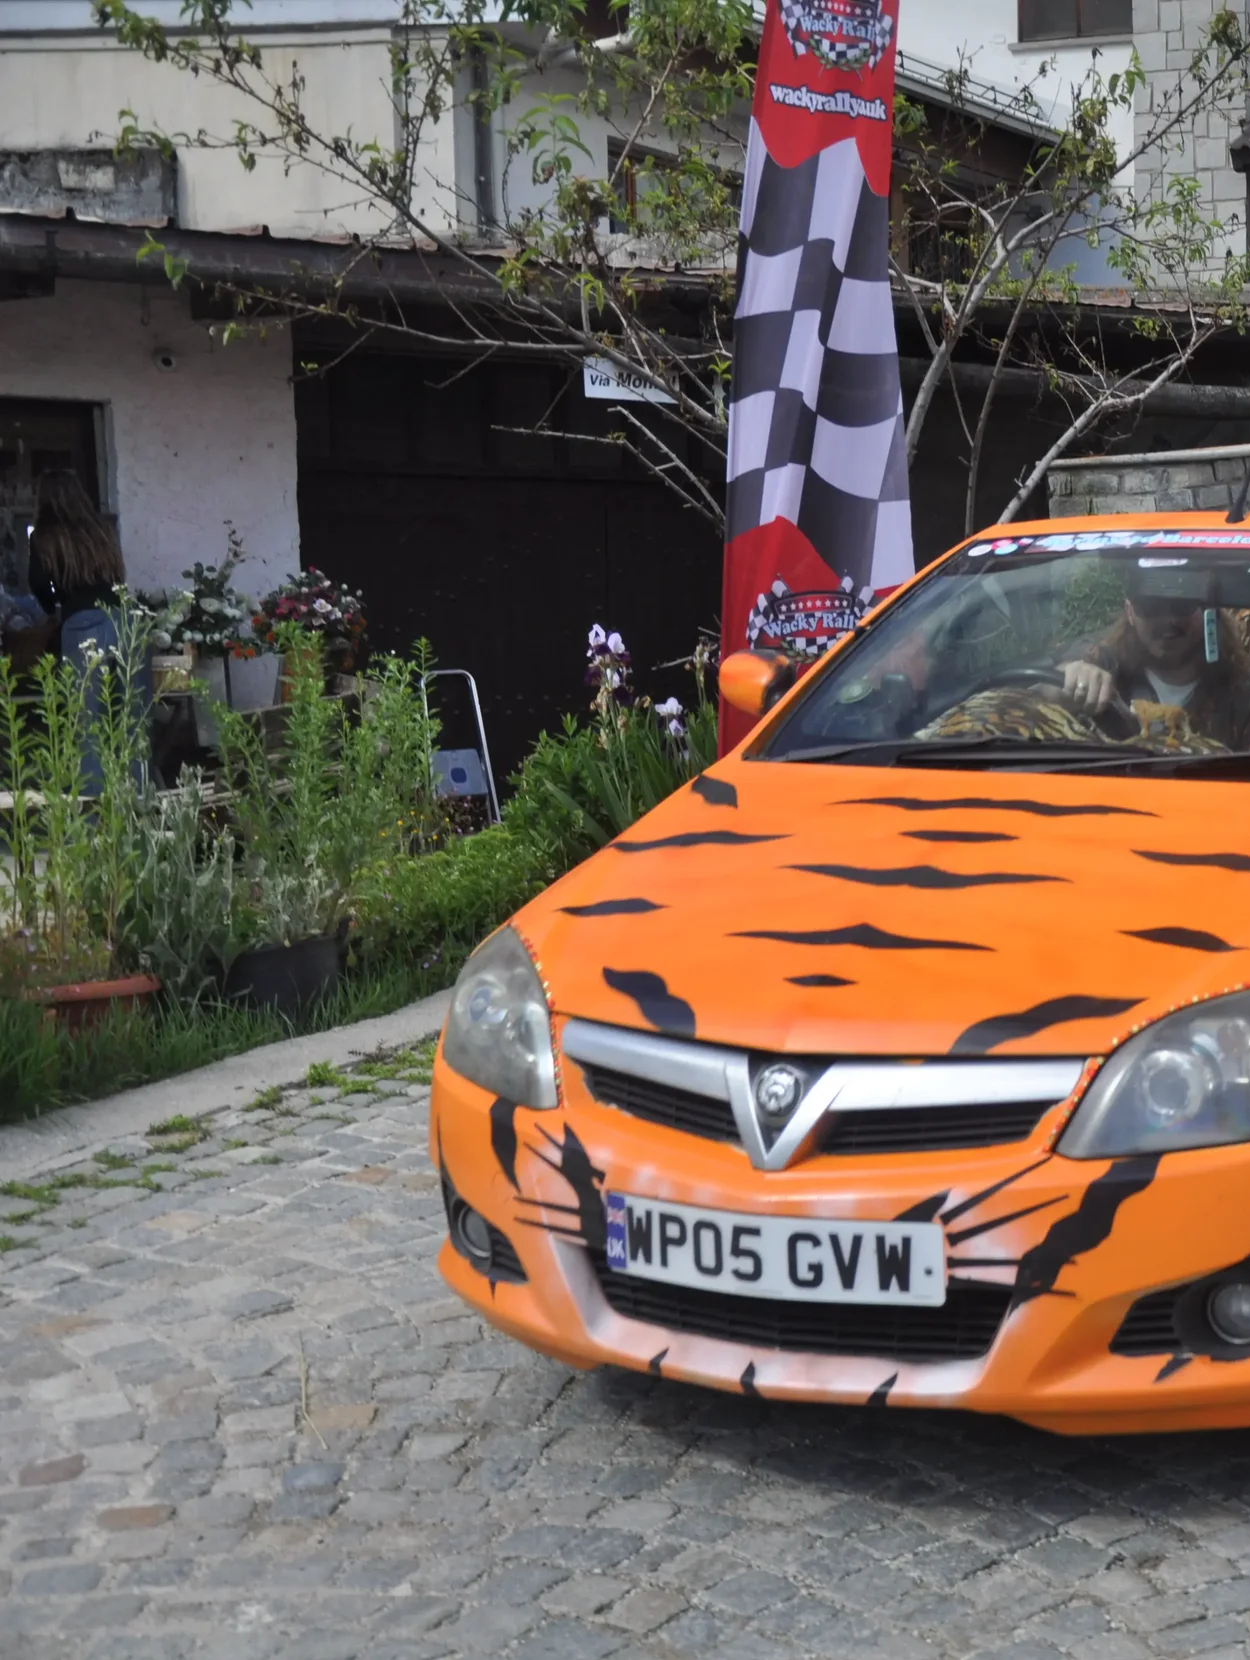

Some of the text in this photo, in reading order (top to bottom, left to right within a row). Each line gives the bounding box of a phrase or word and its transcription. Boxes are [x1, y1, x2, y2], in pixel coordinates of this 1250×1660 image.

[800, 13, 878, 40] Wacky Rall
[590, 374, 610, 387] Via
[762, 611, 862, 640] Wacky Rall
[607, 1237, 626, 1261] UK
[627, 1205, 912, 1293] WP05 GVW
